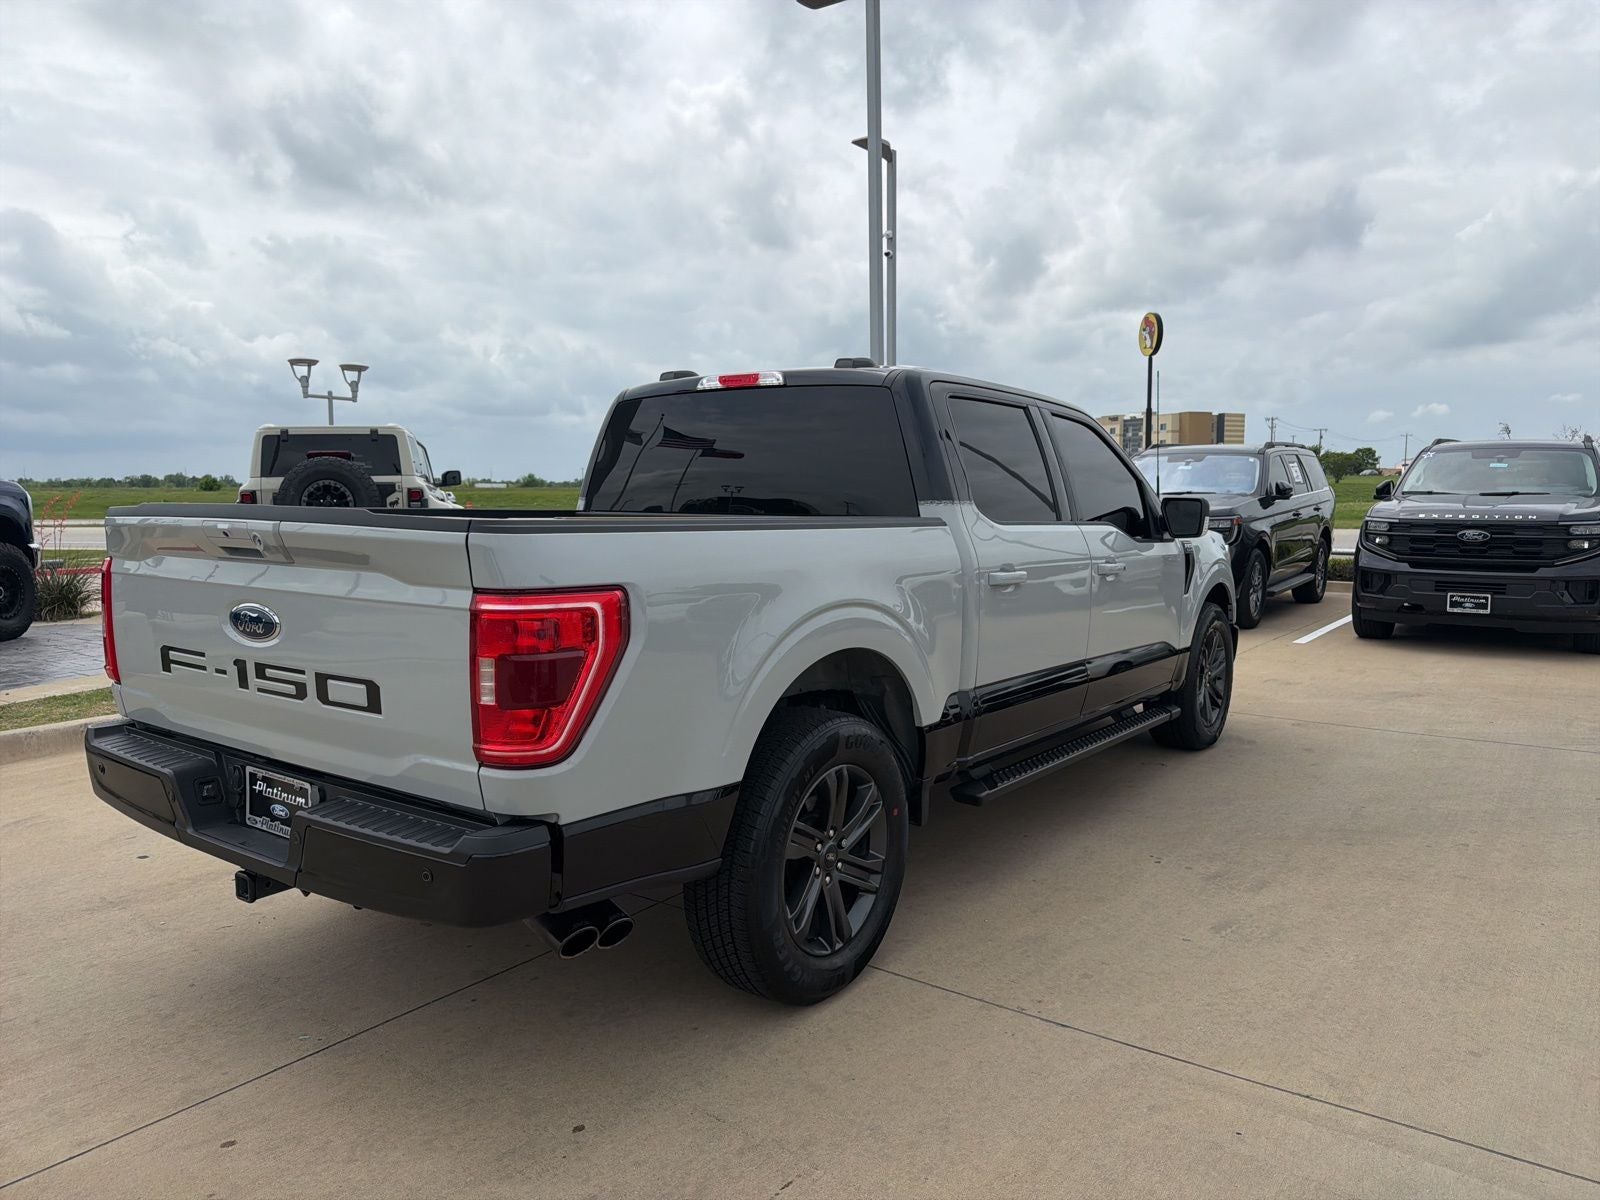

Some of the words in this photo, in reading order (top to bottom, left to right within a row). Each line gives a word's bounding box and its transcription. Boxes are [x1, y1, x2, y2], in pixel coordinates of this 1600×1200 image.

[1463, 531, 1484, 541] Ford
[238, 610, 265, 633] Ford
[160, 645, 383, 717] F-150
[252, 780, 309, 808] Platinum
[261, 817, 291, 835] Platinu
